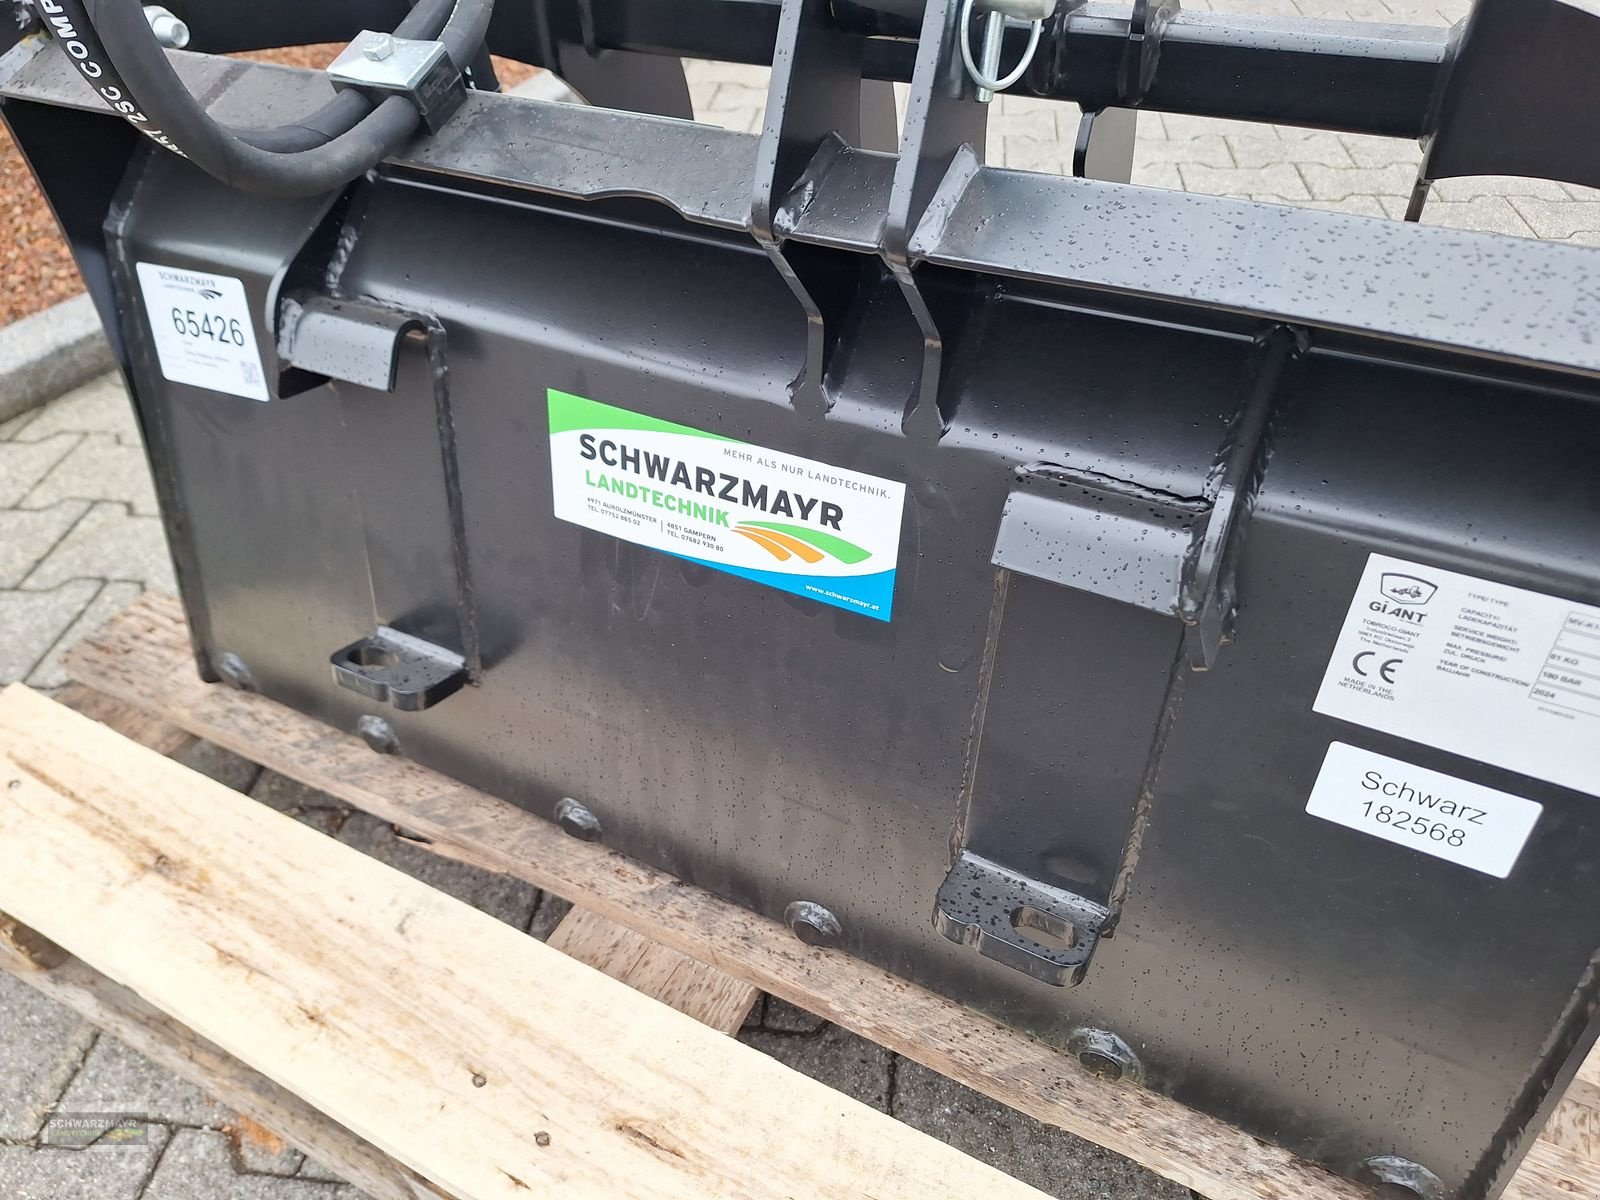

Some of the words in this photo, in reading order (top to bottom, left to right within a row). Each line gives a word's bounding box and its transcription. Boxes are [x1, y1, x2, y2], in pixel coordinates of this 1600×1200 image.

[100, 86, 148, 124] 2SC
[172, 307, 244, 346] 65426
[579, 433, 844, 531] SCHWARZMAYR
[723, 448, 752, 462] MEHR
[757, 457, 777, 469] ALS
[781, 463, 804, 476] NUR
[808, 470, 891, 499] LANDTECHNIK.
[585, 469, 730, 528] LANDTECHNIK
[587, 497, 601, 506] 4971
[602, 502, 657, 523] AUROLZMÜNSTER
[587, 504, 599, 513] TEL.
[601, 509, 619, 519] 07752
[620, 515, 632, 524] 865
[667, 522, 682, 532] 4851
[683, 527, 716, 542] GAMPERN
[667, 530, 680, 539] TEL.
[681, 534, 700, 545] 07682
[702, 540, 715, 549] 930
[716, 543, 724, 552] 80
[805, 584, 880, 611] www.schwarzmayr.at
[1490, 598, 1509, 606] TYPE
[1453, 624, 1485, 637] SERVICE
[1451, 631, 1520, 653] BETRIEBSGEWICHT
[1440, 659, 1458, 668] YEAR
[1460, 653, 1486, 663] DRUCK
[1563, 657, 1579, 666] KG
[1436, 665, 1470, 678] BAUJAHR
[1560, 676, 1582, 686] BAR
[1337, 681, 1394, 701] NETHERLANDS
[1344, 676, 1365, 687] MADE
[1378, 687, 1392, 695] THE
[1533, 688, 1555, 699] 2024
[1361, 771, 1487, 825] Schwarz
[1363, 801, 1466, 847] 182568
